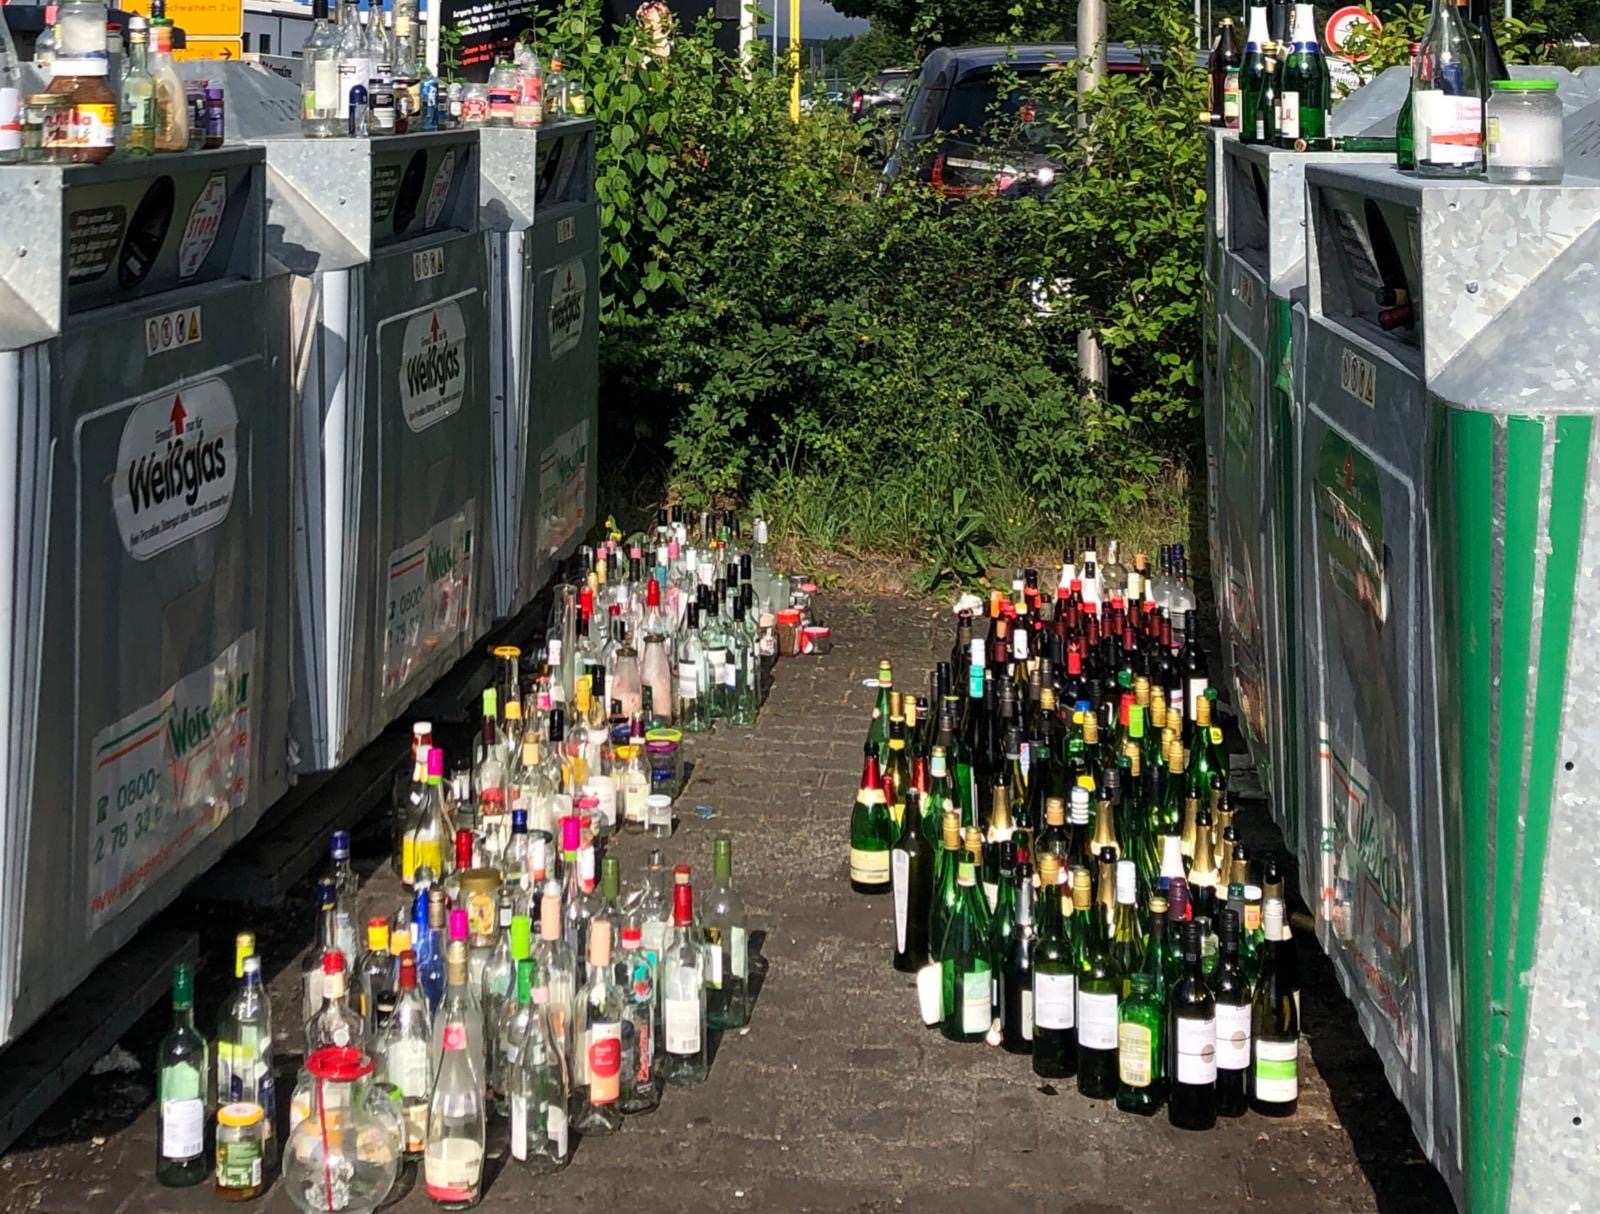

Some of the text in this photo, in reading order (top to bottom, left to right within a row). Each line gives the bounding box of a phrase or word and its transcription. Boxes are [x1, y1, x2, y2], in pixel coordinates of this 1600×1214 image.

[187, 215, 218, 239] STOPP
[407, 341, 460, 398] Weißglas
[128, 430, 226, 515] Weißglas
[111, 823, 128, 852] 78
